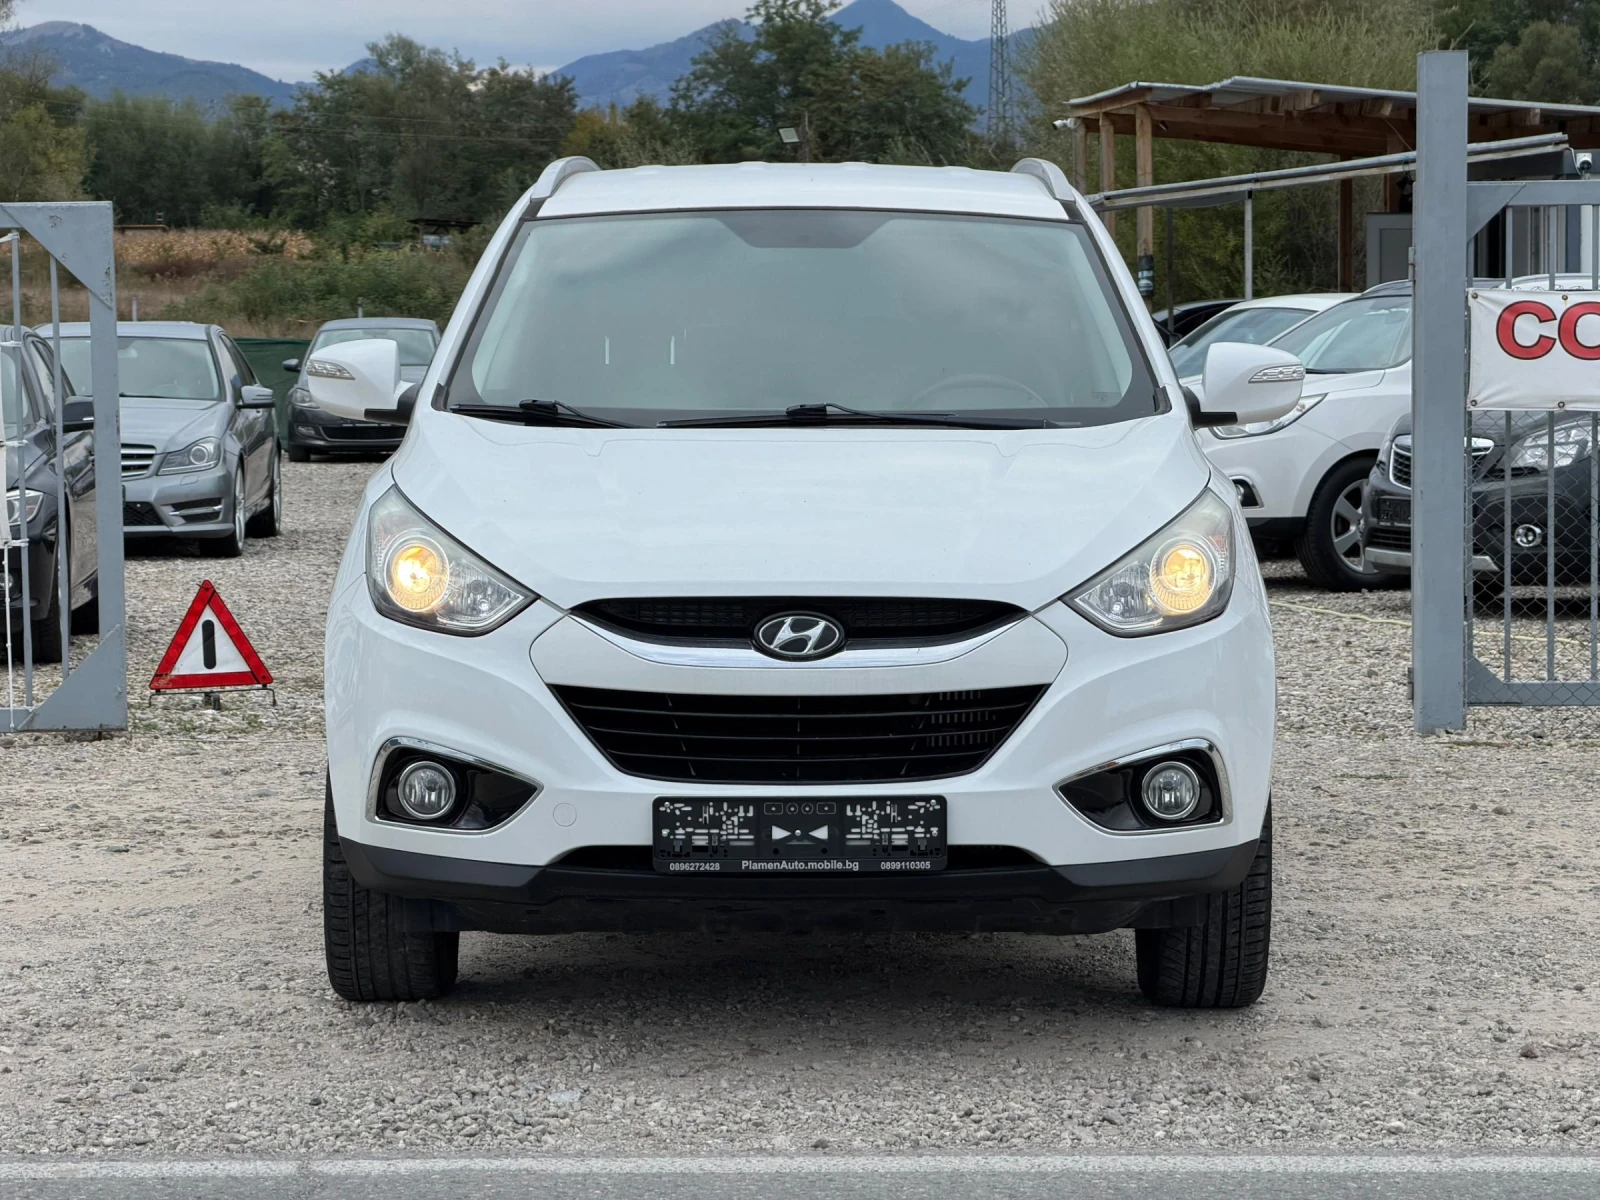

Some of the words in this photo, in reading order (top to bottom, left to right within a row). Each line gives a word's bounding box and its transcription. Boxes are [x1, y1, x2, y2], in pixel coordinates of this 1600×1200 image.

[669, 862, 721, 871] 0896272428
[741, 860, 859, 871] PlamenAuto.mobile.bg
[880, 861, 931, 870] 0899110305
